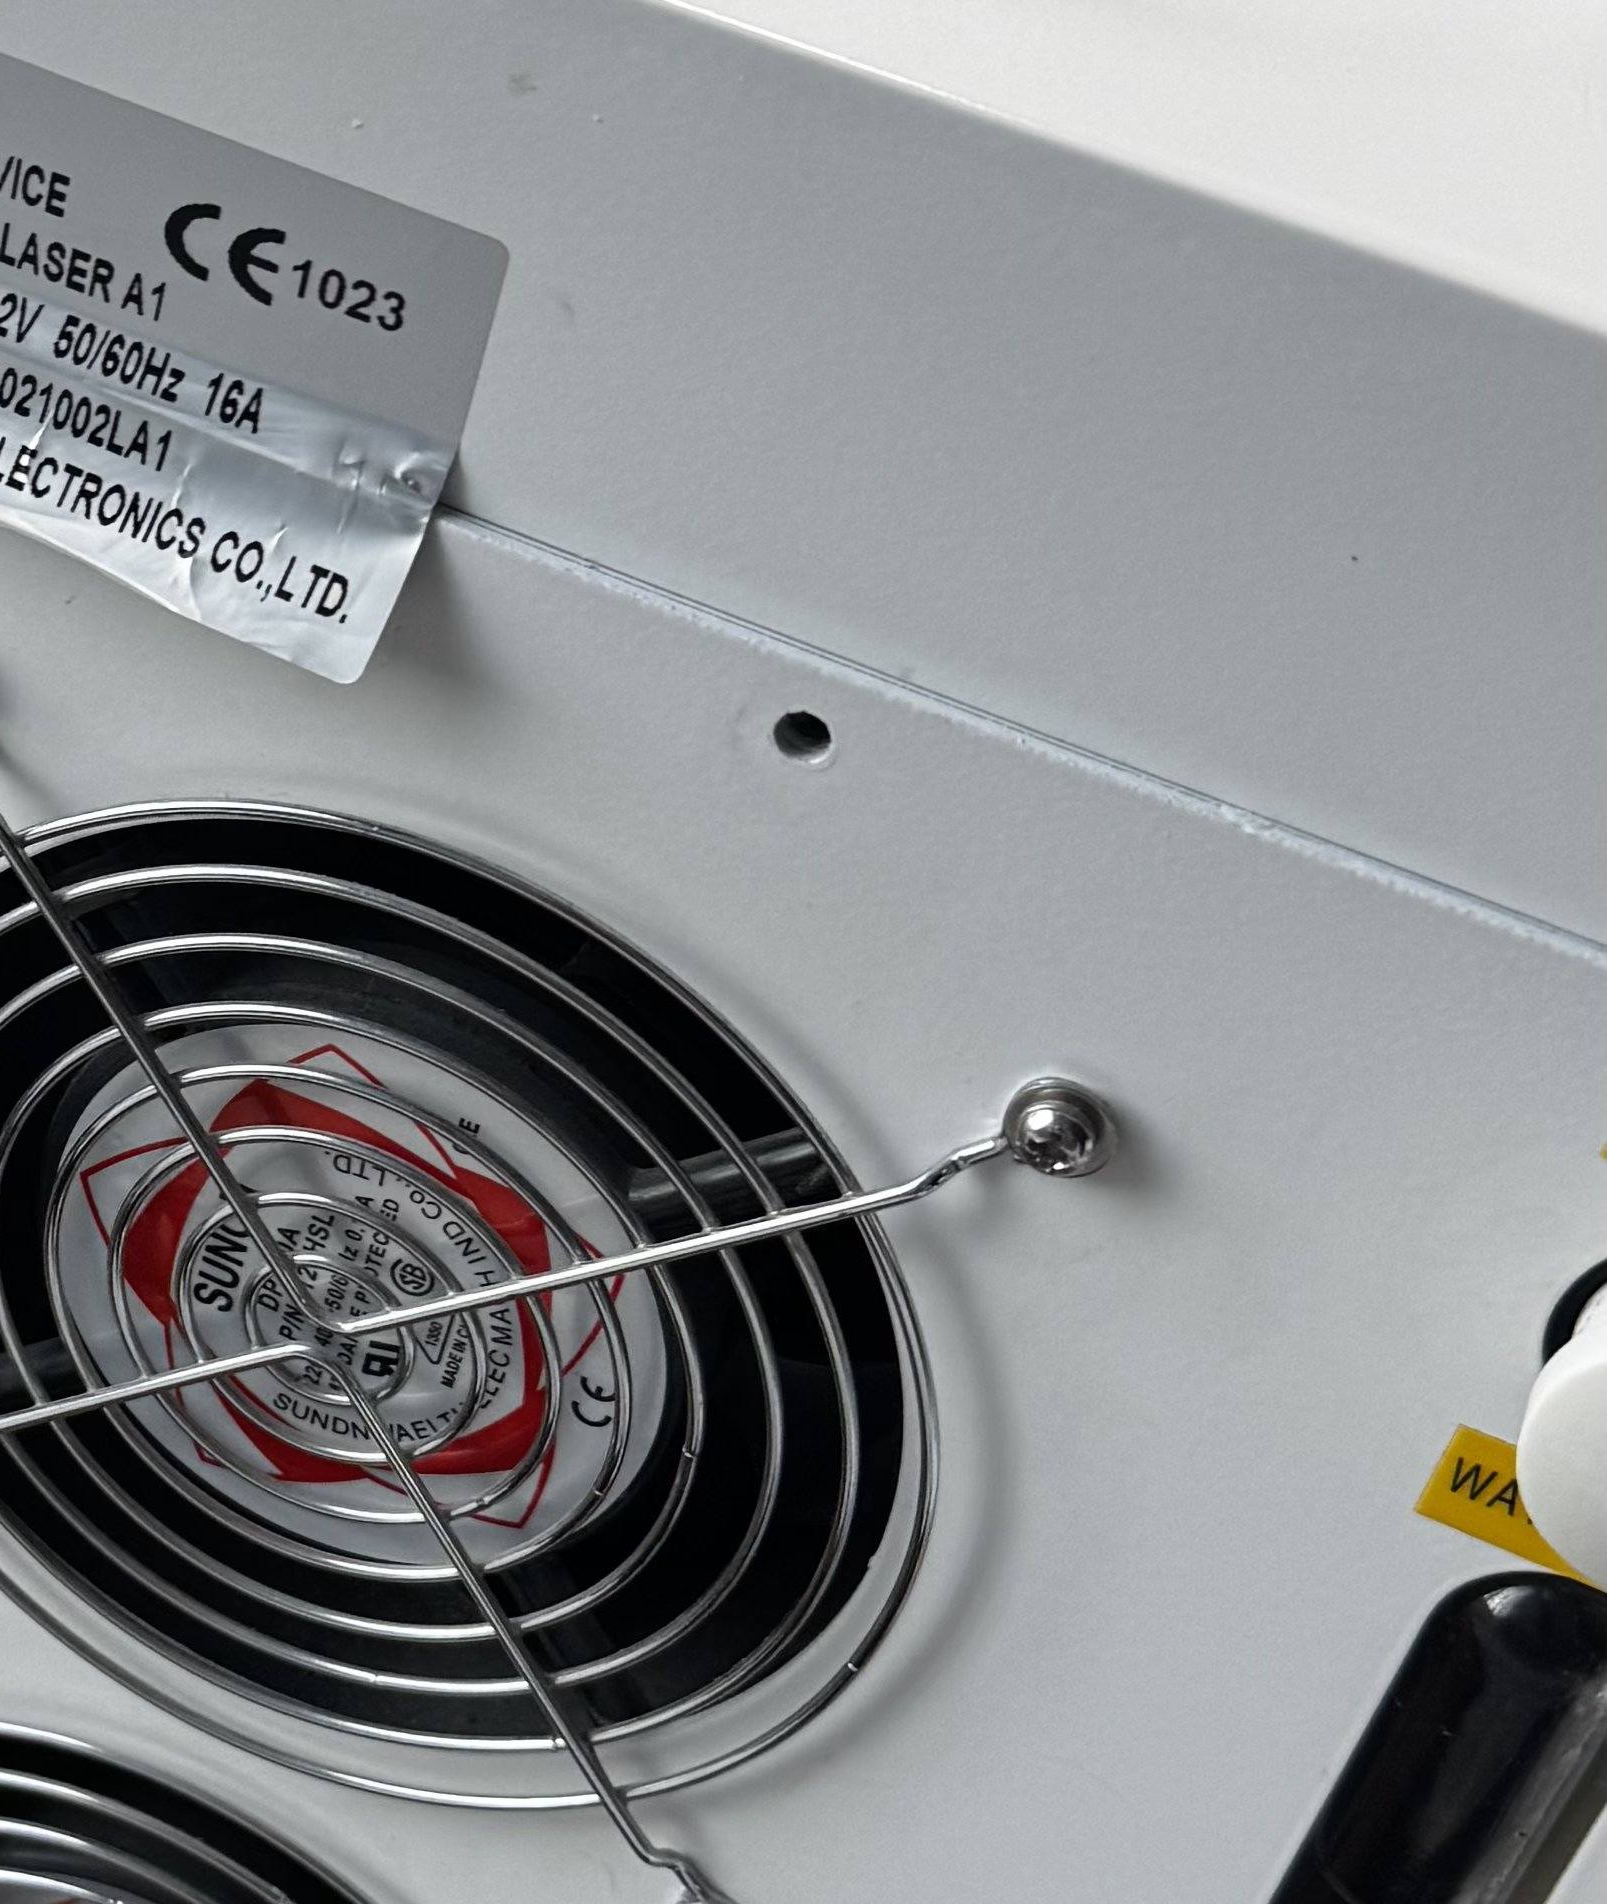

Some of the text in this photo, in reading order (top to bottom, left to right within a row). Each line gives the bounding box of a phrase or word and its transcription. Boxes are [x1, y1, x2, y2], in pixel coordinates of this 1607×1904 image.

[164, 202, 287, 307] CE
[120, 272, 167, 322] A1
[292, 259, 406, 332] 1023
[52, 314, 187, 403] 50/60Hz
[204, 372, 264, 434] 16A
[442, 1221, 487, 1265] IND
[440, 1354, 464, 1389] MADE
